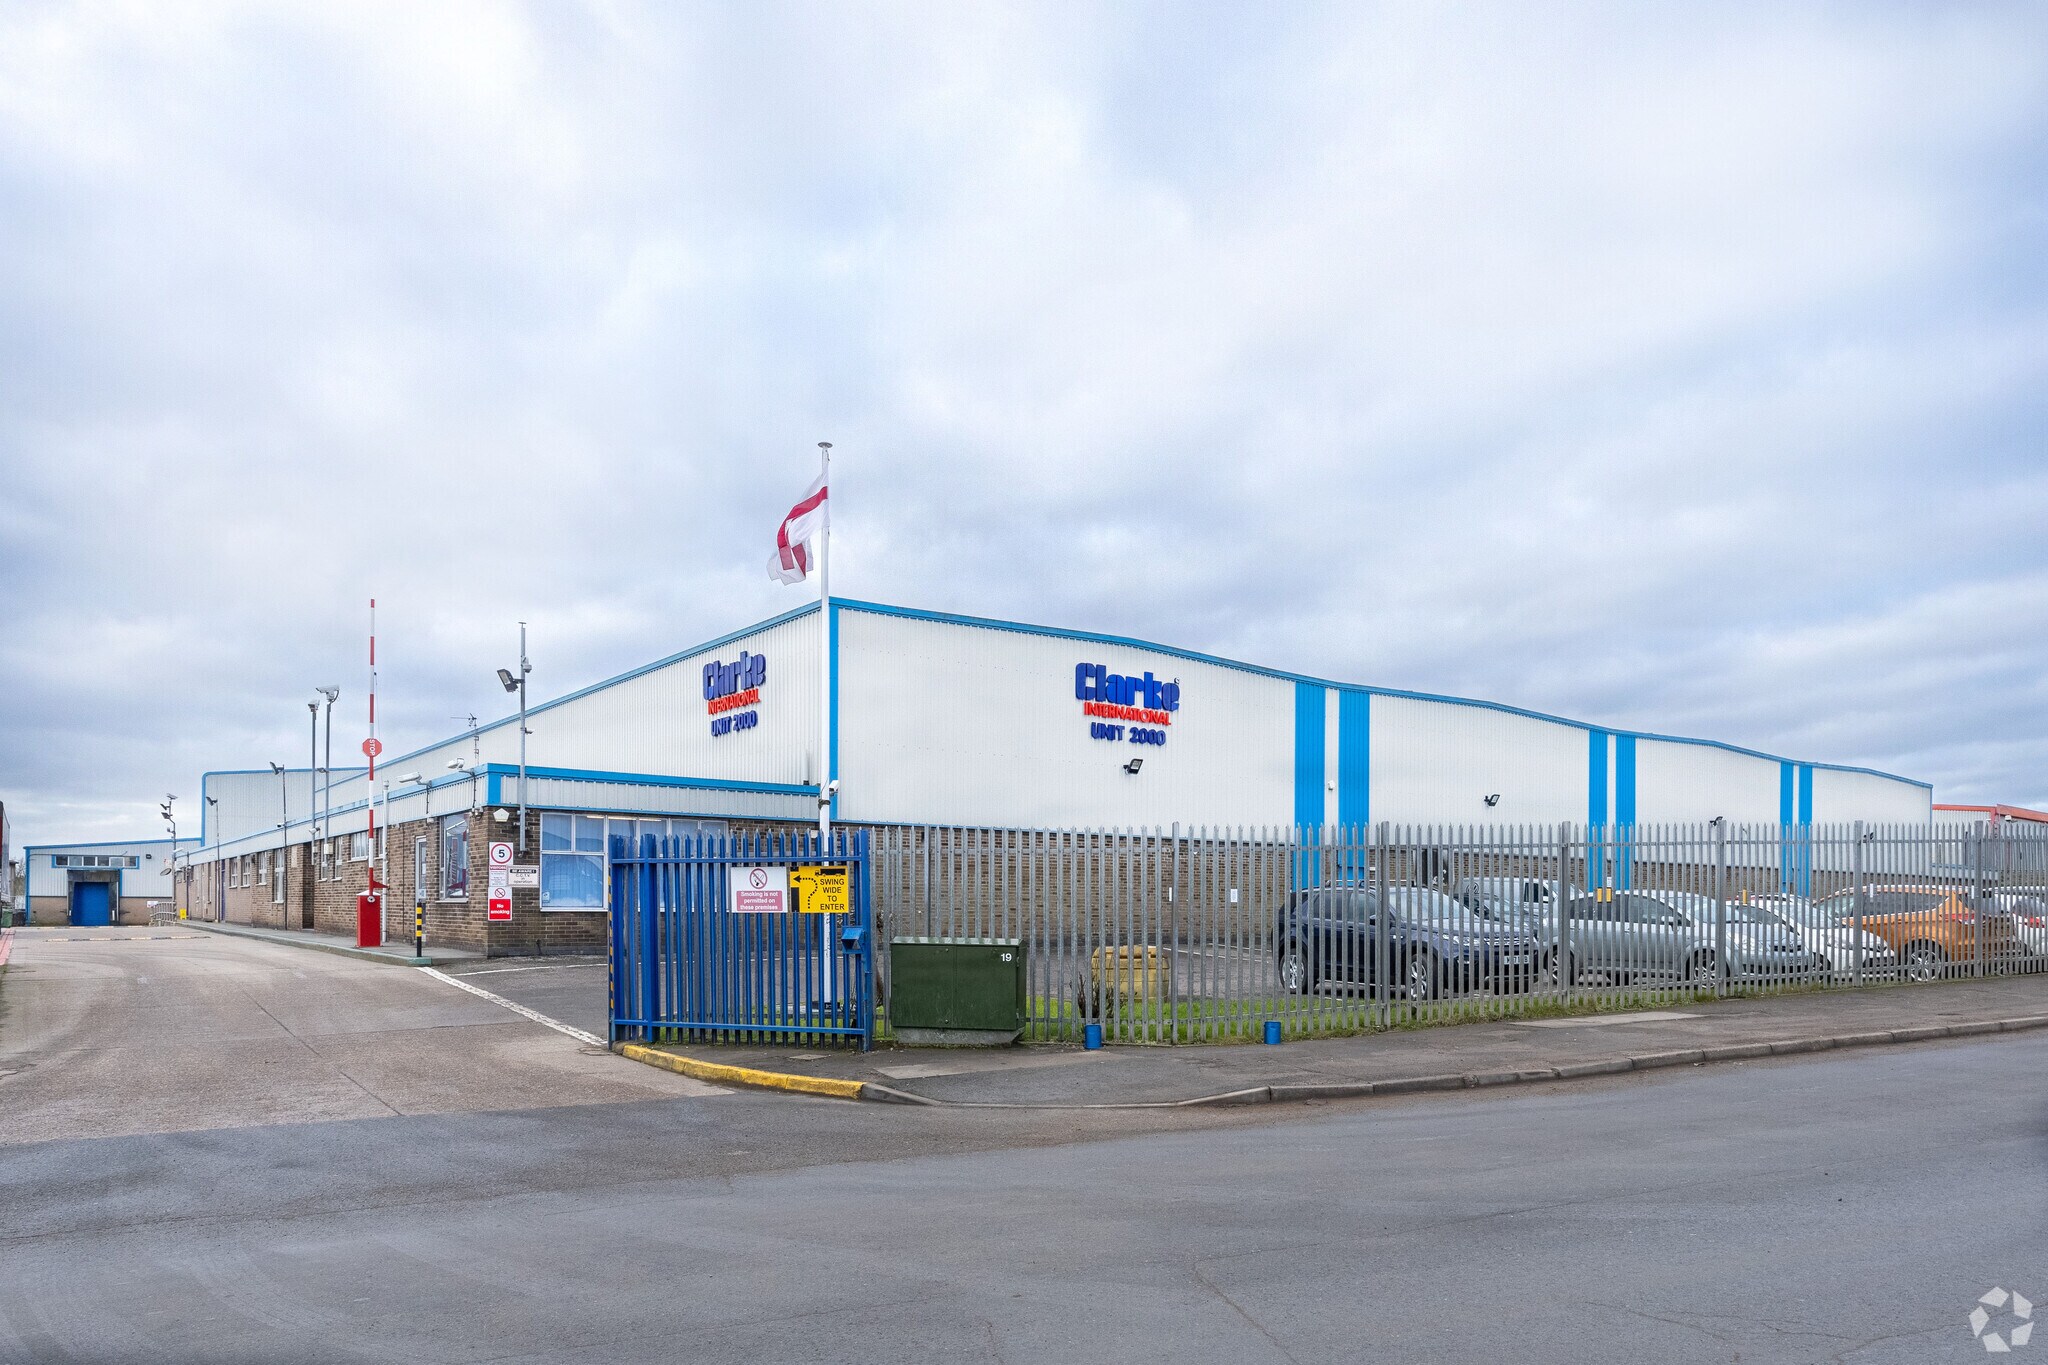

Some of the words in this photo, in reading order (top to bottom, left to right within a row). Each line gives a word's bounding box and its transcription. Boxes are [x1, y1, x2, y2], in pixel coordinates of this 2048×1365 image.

[703, 651, 766, 701] Clarke
[1075, 662, 1180, 712] Clarke
[708, 688, 761, 715] INTERNATIONAL
[1084, 701, 1171, 726] INTERNATIONAL
[711, 716, 732, 737] UNIT
[733, 710, 758, 732] 2000
[1091, 722, 1125, 741] UNIT
[1129, 727, 1166, 746] 2000
[498, 849, 505, 858] 5
[1001, 953, 1012, 961] 19
